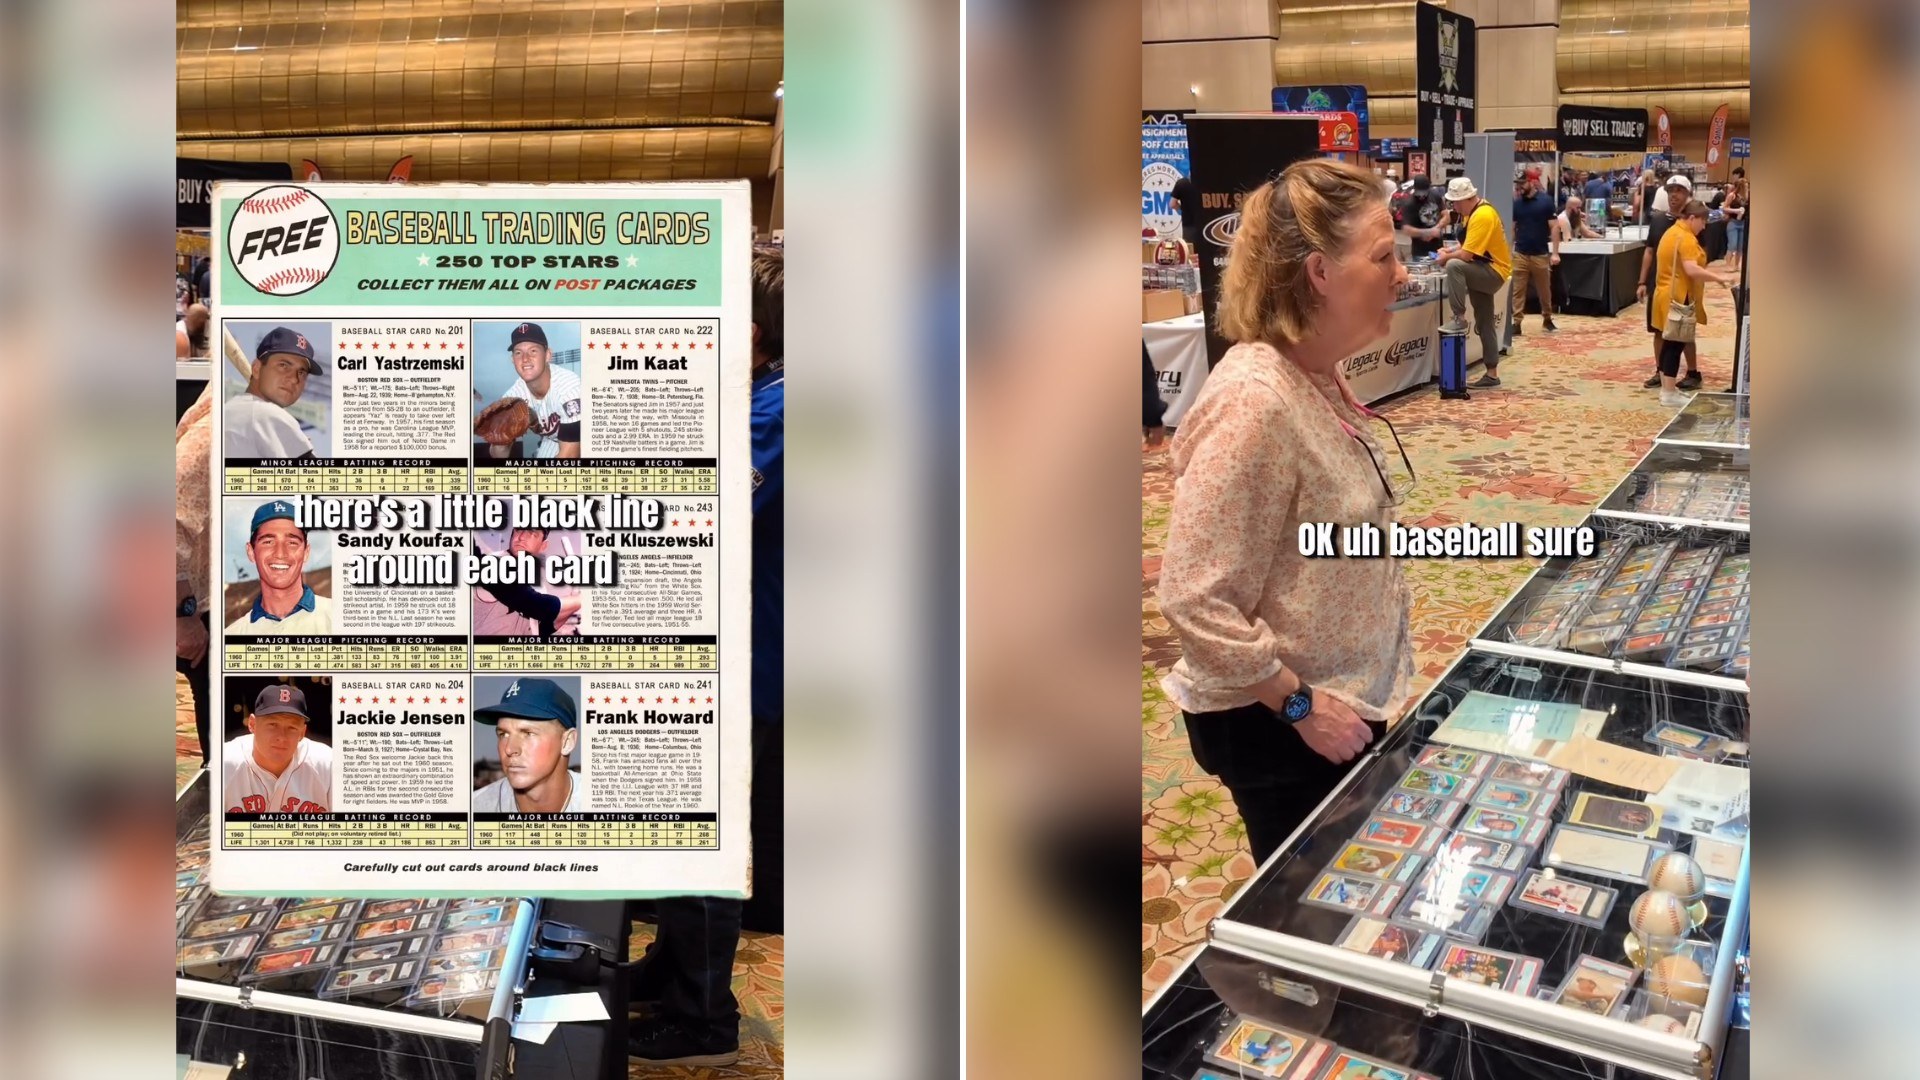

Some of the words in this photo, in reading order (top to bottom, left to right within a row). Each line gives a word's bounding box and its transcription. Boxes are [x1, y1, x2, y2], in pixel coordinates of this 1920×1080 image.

[1572, 119, 1589, 136] BUY
[1590, 120, 1609, 136] SELL
[1611, 121, 1636, 137] TRADE
[1529, 140, 1545, 151] SELL
[178, 179, 203, 204] BUY
[1142, 190, 1182, 216] GM
[1202, 193, 1232, 208] BUY.
[346, 210, 476, 245] BASEBALL
[483, 210, 605, 245] TRADING
[616, 210, 710, 245] CARDS
[237, 215, 330, 265] FREE
[436, 255, 484, 268] 250
[492, 255, 537, 268] TOP
[542, 255, 619, 268] STARS
[357, 279, 434, 290] COLLECT
[437, 279, 484, 290] THEM
[488, 279, 520, 290] ALL
[524, 279, 551, 290] ON
[554, 279, 600, 290] POST
[604, 279, 696, 290] PACKAGES
[448, 326, 463, 334] 201
[697, 326, 713, 334] 222
[1393, 336, 1428, 356] Legacy
[337, 356, 367, 370] Carl
[374, 356, 464, 370] Yastrzemski
[608, 356, 638, 370] Jim
[644, 356, 688, 370] Kaat
[1346, 349, 1382, 371] Legacy
[697, 503, 713, 512] 243
[338, 533, 394, 550] Sandy
[400, 533, 464, 547] Koufax
[586, 533, 615, 547] Ted
[620, 533, 713, 547] Kluszewski
[448, 680, 464, 689] 204
[697, 680, 712, 689] 241
[337, 710, 396, 724] Jackie
[400, 710, 465, 724] Jensen
[586, 710, 638, 724] Frank
[644, 710, 713, 724] Howard
[344, 863, 399, 873] Carefully
[402, 864, 421, 872] cut
[425, 864, 445, 872] out
[449, 863, 483, 872] cards
[487, 863, 530, 872] around
[533, 863, 566, 872] black
[570, 863, 598, 872] lines
